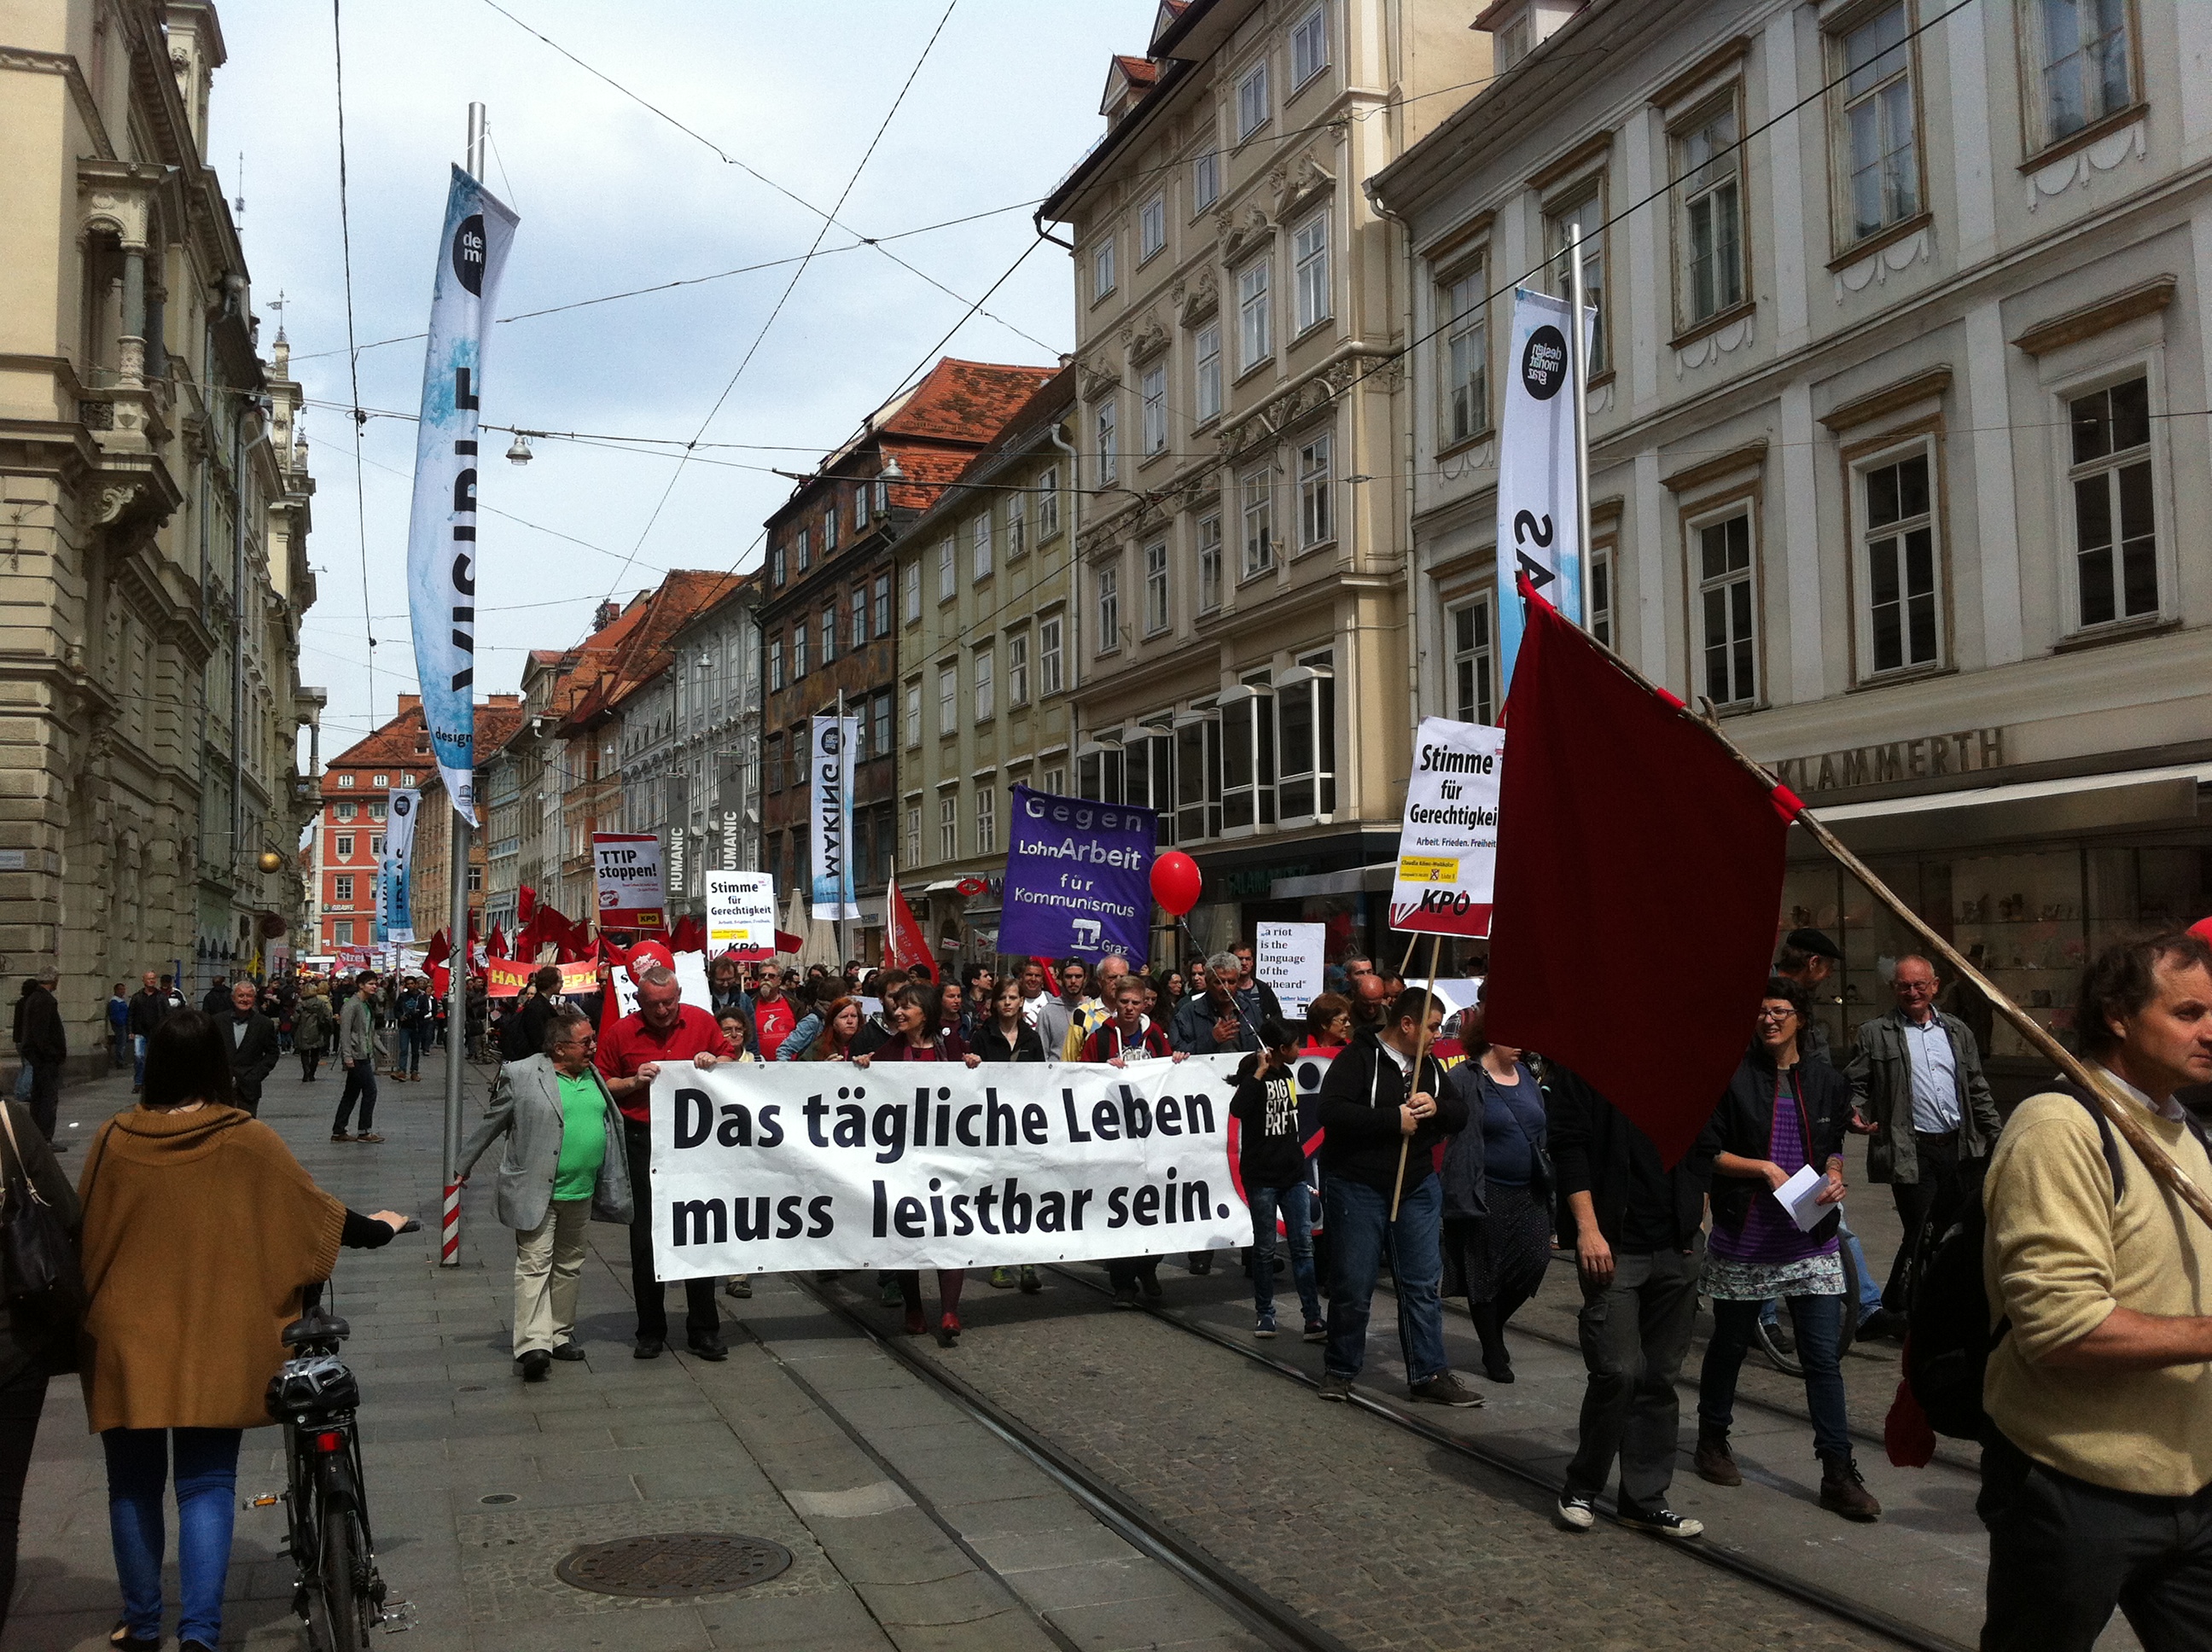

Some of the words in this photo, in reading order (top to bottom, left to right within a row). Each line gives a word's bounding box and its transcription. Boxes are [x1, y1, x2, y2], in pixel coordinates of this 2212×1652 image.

[1420, 744, 1493, 775] Stimme
[1776, 727, 2004, 794] KLAMMERTH
[1441, 779, 1463, 800] für
[1025, 797, 1142, 833] Gegen
[1410, 804, 1498, 830] Gerechtigkei
[723, 811, 737, 870] UMANIC
[599, 850, 637, 864] TTIP
[670, 827, 684, 892] HUMANIC
[1019, 837, 1142, 871] LohnArbeit
[599, 863, 657, 881] stoppen!
[711, 881, 759, 894] Stimme
[1060, 873, 1094, 892] für
[728, 896, 742, 905] für
[1015, 887, 1136, 918] Kommunismus
[711, 905, 771, 917] Gerechtigkeit
[1273, 928, 1293, 937] riot
[1101, 939, 1129, 957] Graz
[1260, 940, 1269, 949] is
[1272, 939, 1288, 950] the
[1260, 953, 1306, 966] language
[1260, 966, 1271, 975] of
[1272, 967, 1289, 975] the
[1265, 1078, 1289, 1101] BIG
[1266, 1097, 1289, 1114] CITY
[673, 1088, 784, 1150] Das
[802, 1086, 1049, 1164] tägliche
[1062, 1085, 1216, 1143] Leben
[672, 1195, 835, 1248] muss
[872, 1176, 1093, 1239] leistbar
[1107, 1166, 1231, 1230] sein.
